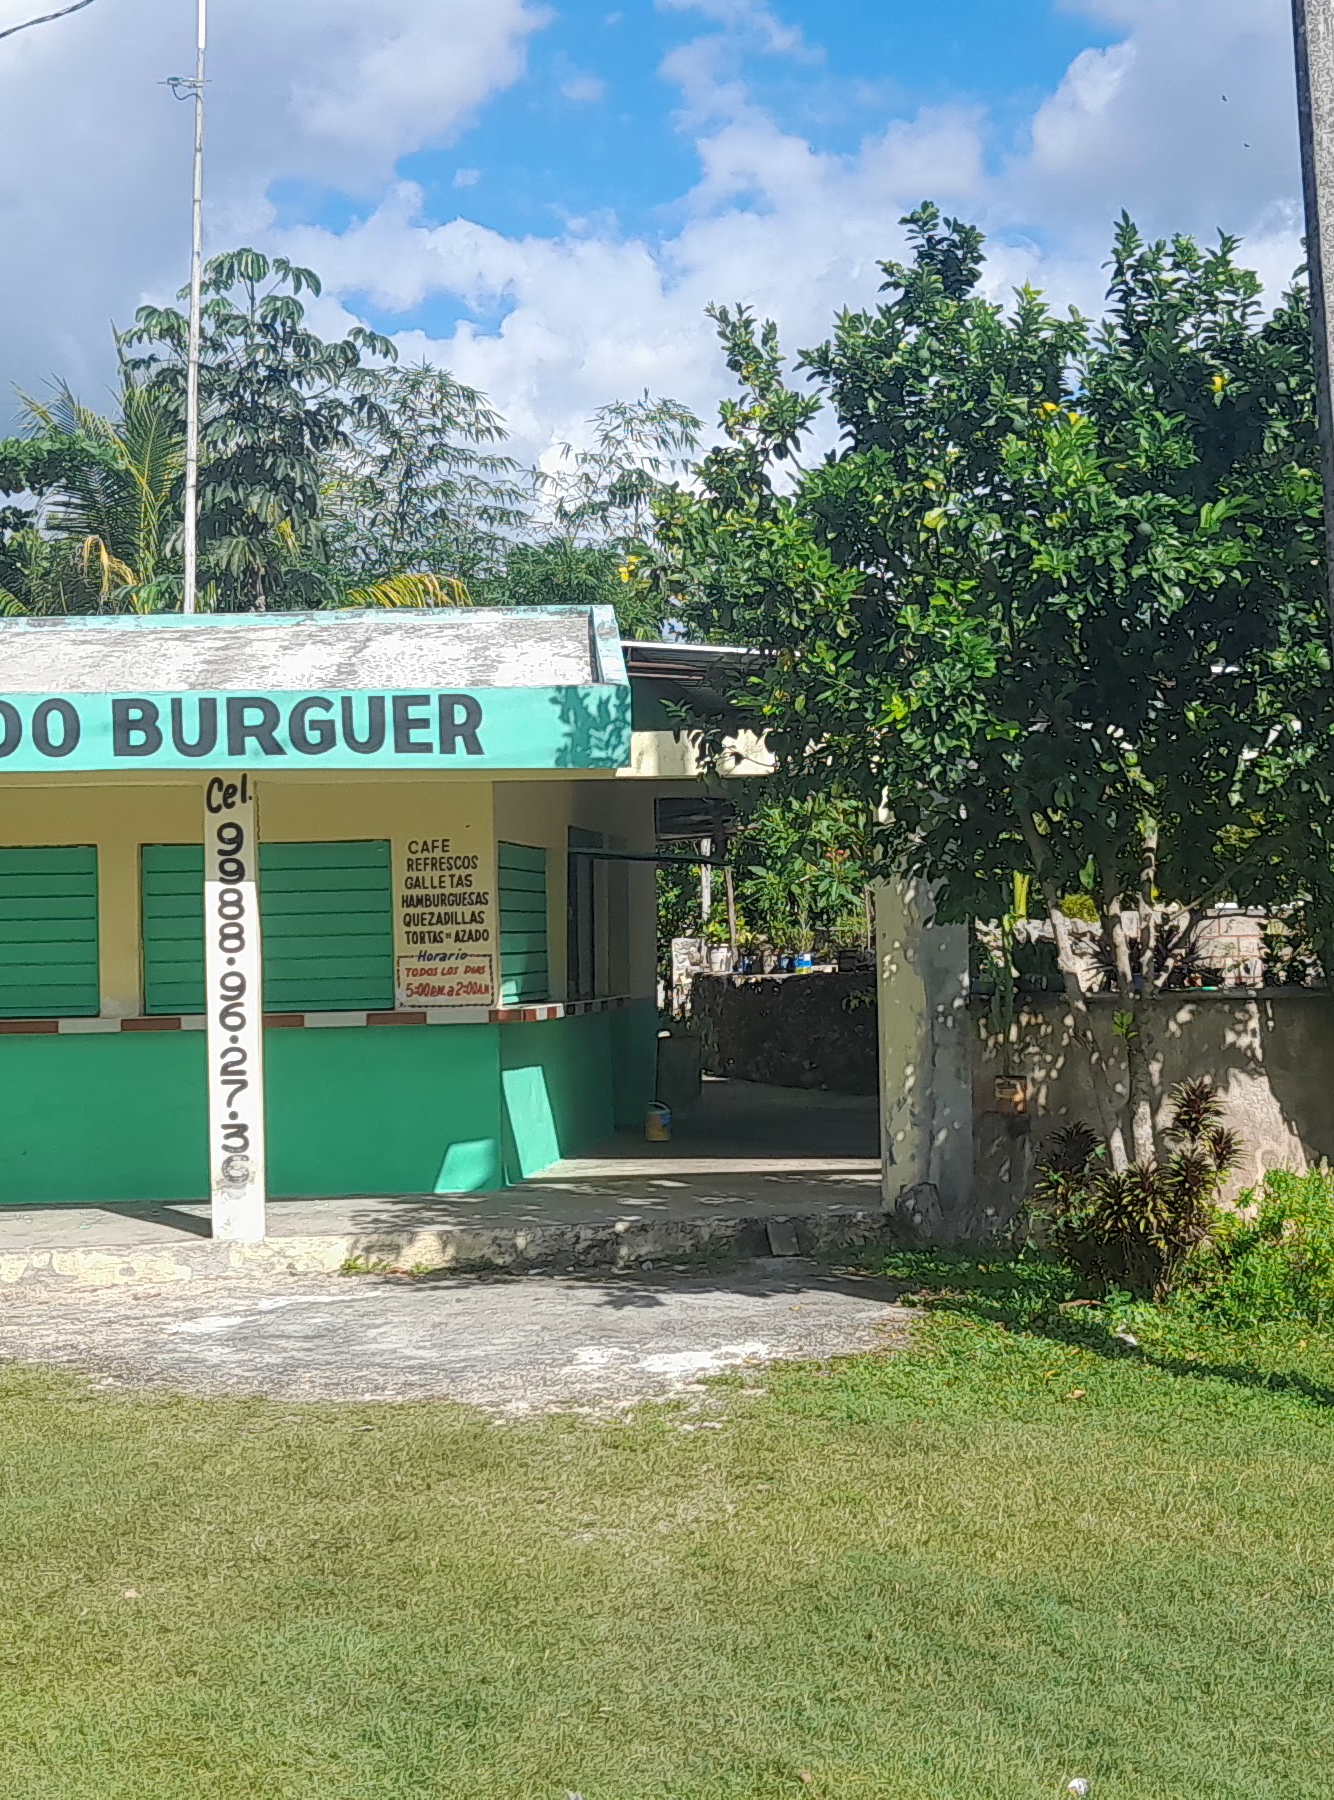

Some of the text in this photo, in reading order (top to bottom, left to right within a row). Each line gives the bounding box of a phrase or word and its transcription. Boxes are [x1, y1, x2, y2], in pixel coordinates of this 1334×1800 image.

[110, 693, 485, 758] BURGUER
[206, 772, 253, 814] Cel.
[408, 839, 450, 854] CAFE
[407, 855, 479, 872] REFRESCOS
[404, 873, 473, 890] GALLETAS
[401, 891, 489, 908] HAMBURGUESAS
[403, 910, 485, 927] QUEZADILLAS
[405, 930, 444, 945] TORTAS
[454, 929, 490, 943] AZADO
[417, 948, 468, 962] Horario
[405, 965, 486, 977] TODOS LOS DIAS
